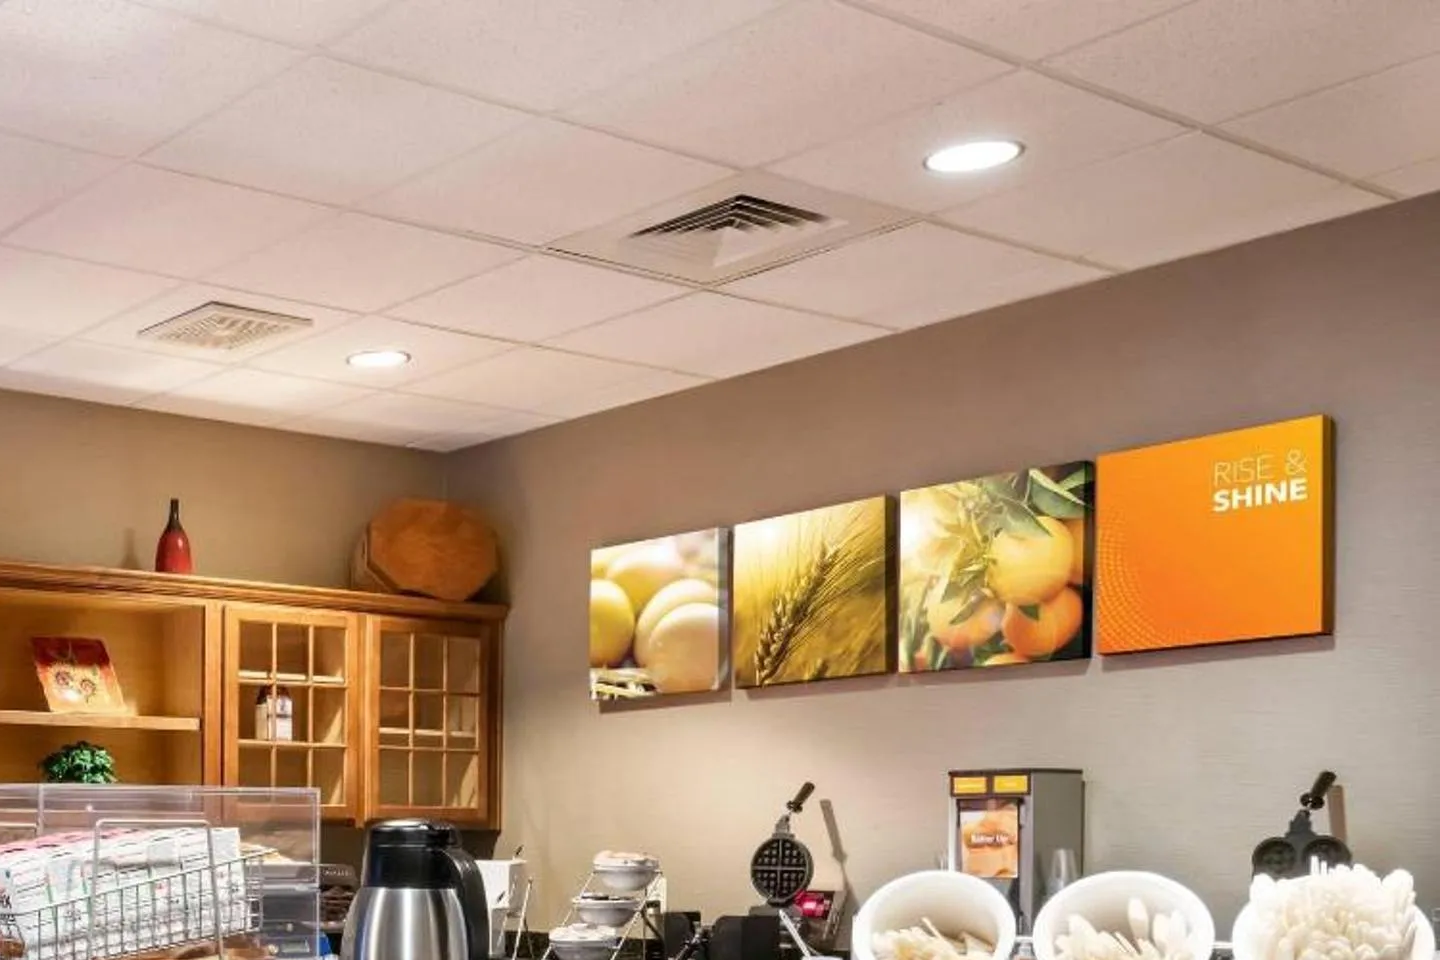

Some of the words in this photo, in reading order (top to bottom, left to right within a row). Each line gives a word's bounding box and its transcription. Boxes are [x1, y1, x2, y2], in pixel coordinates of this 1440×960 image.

[1213, 454, 1275, 487] RISE
[1285, 448, 1307, 475] &
[1212, 477, 1308, 512] SHINE
